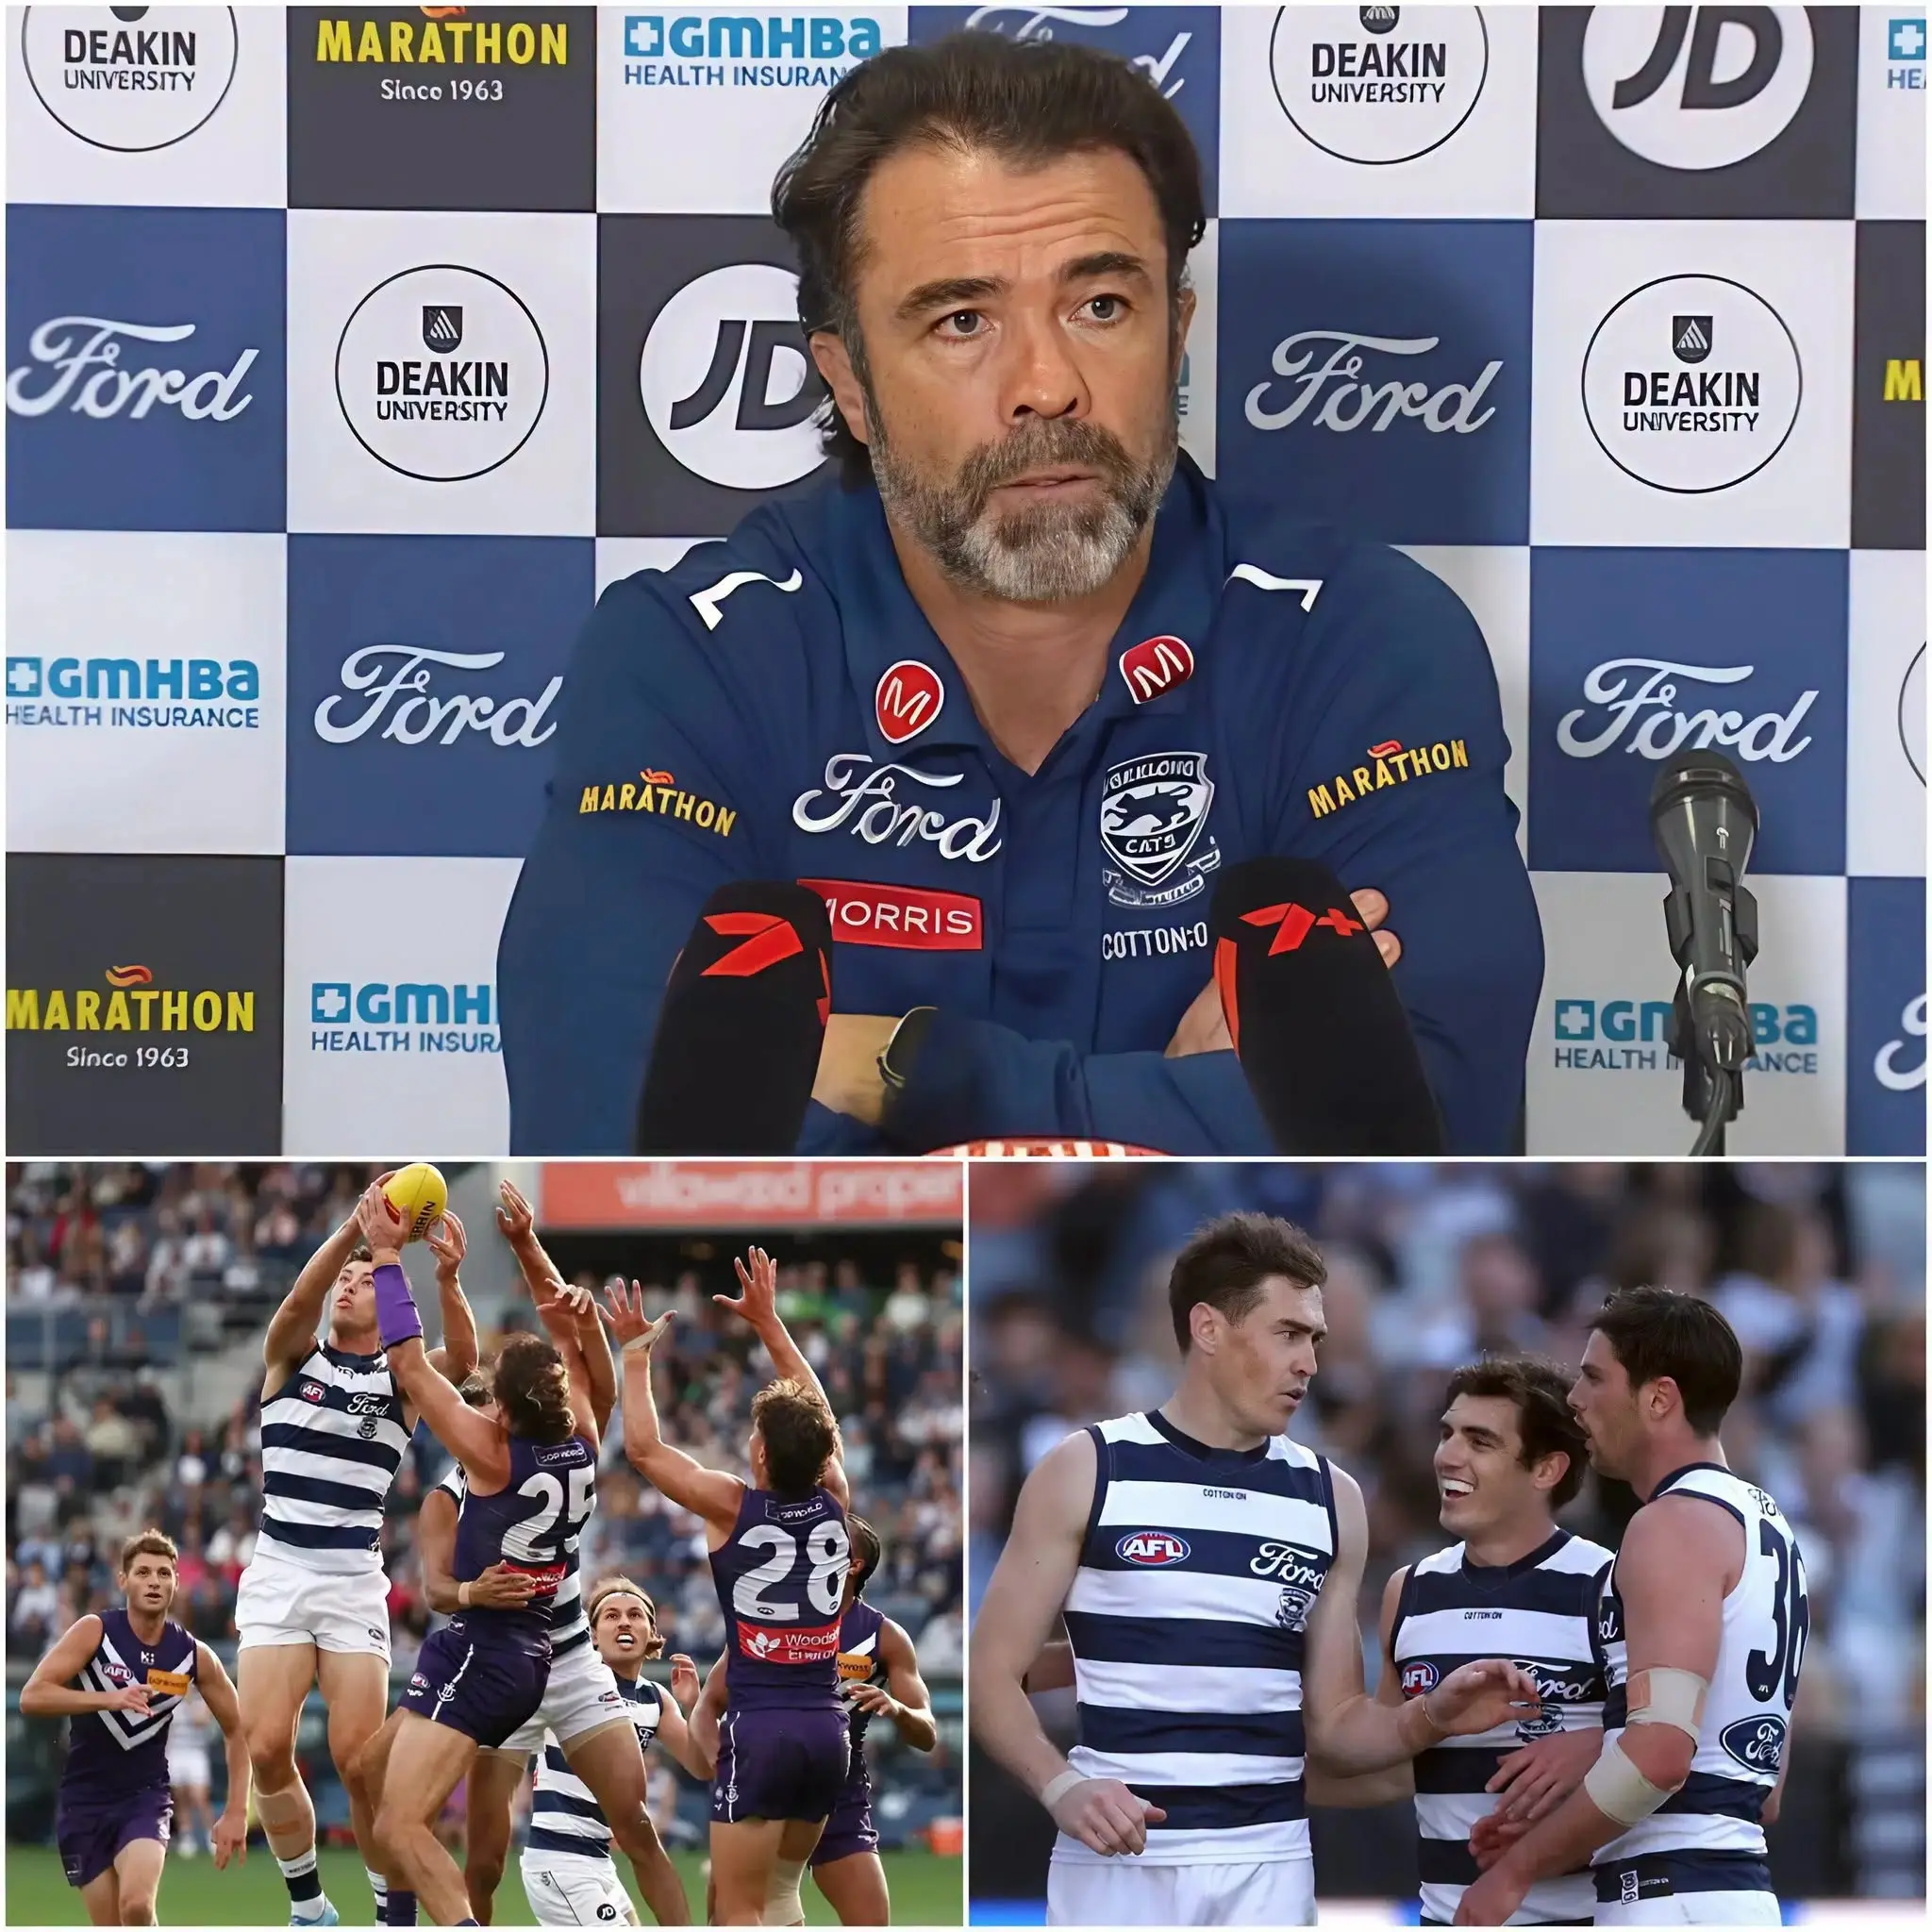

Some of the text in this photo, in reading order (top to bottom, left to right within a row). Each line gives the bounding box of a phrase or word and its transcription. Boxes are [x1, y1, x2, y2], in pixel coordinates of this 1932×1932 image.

[64, 29, 196, 66] DEAKIN
[317, 20, 567, 65] MARATHON
[1311, 42, 1446, 77] DEAKIN
[64, 69, 195, 92] UNIVERSITY
[450, 79, 503, 101] 1963
[625, 64, 848, 87] HEALTH INSURAN
[1311, 82, 1446, 104] UNIVERSITY
[6, 316, 260, 422] Ford
[376, 360, 508, 397] DEAKIN
[1243, 330, 1505, 434] Ford
[1624, 371, 1759, 408] DEAKIN
[376, 400, 508, 422] UNIVERSITY
[1623, 411, 1759, 433] UNIVERSITY
[314, 644, 564, 748] Ford
[1556, 658, 1820, 763] Ford
[6, 705, 258, 728] HEALTH INSURANCE
[1307, 740, 1469, 819] MARATHON
[579, 783, 737, 837] MARATHON
[792, 753, 1003, 862] Ford
[6, 990, 254, 1031] MARATHON
[136, 1047, 189, 1068] 1963
[312, 1031, 503, 1054] HEALTH INSUR
[1555, 1048, 1656, 1070] HEALTH
[501, 1464, 597, 1562] 25
[1122, 1538, 1185, 1559] AFL
[733, 1520, 850, 1621] 28
[1746, 1518, 1809, 1711] 36
[1402, 1671, 1434, 1690] AFL
